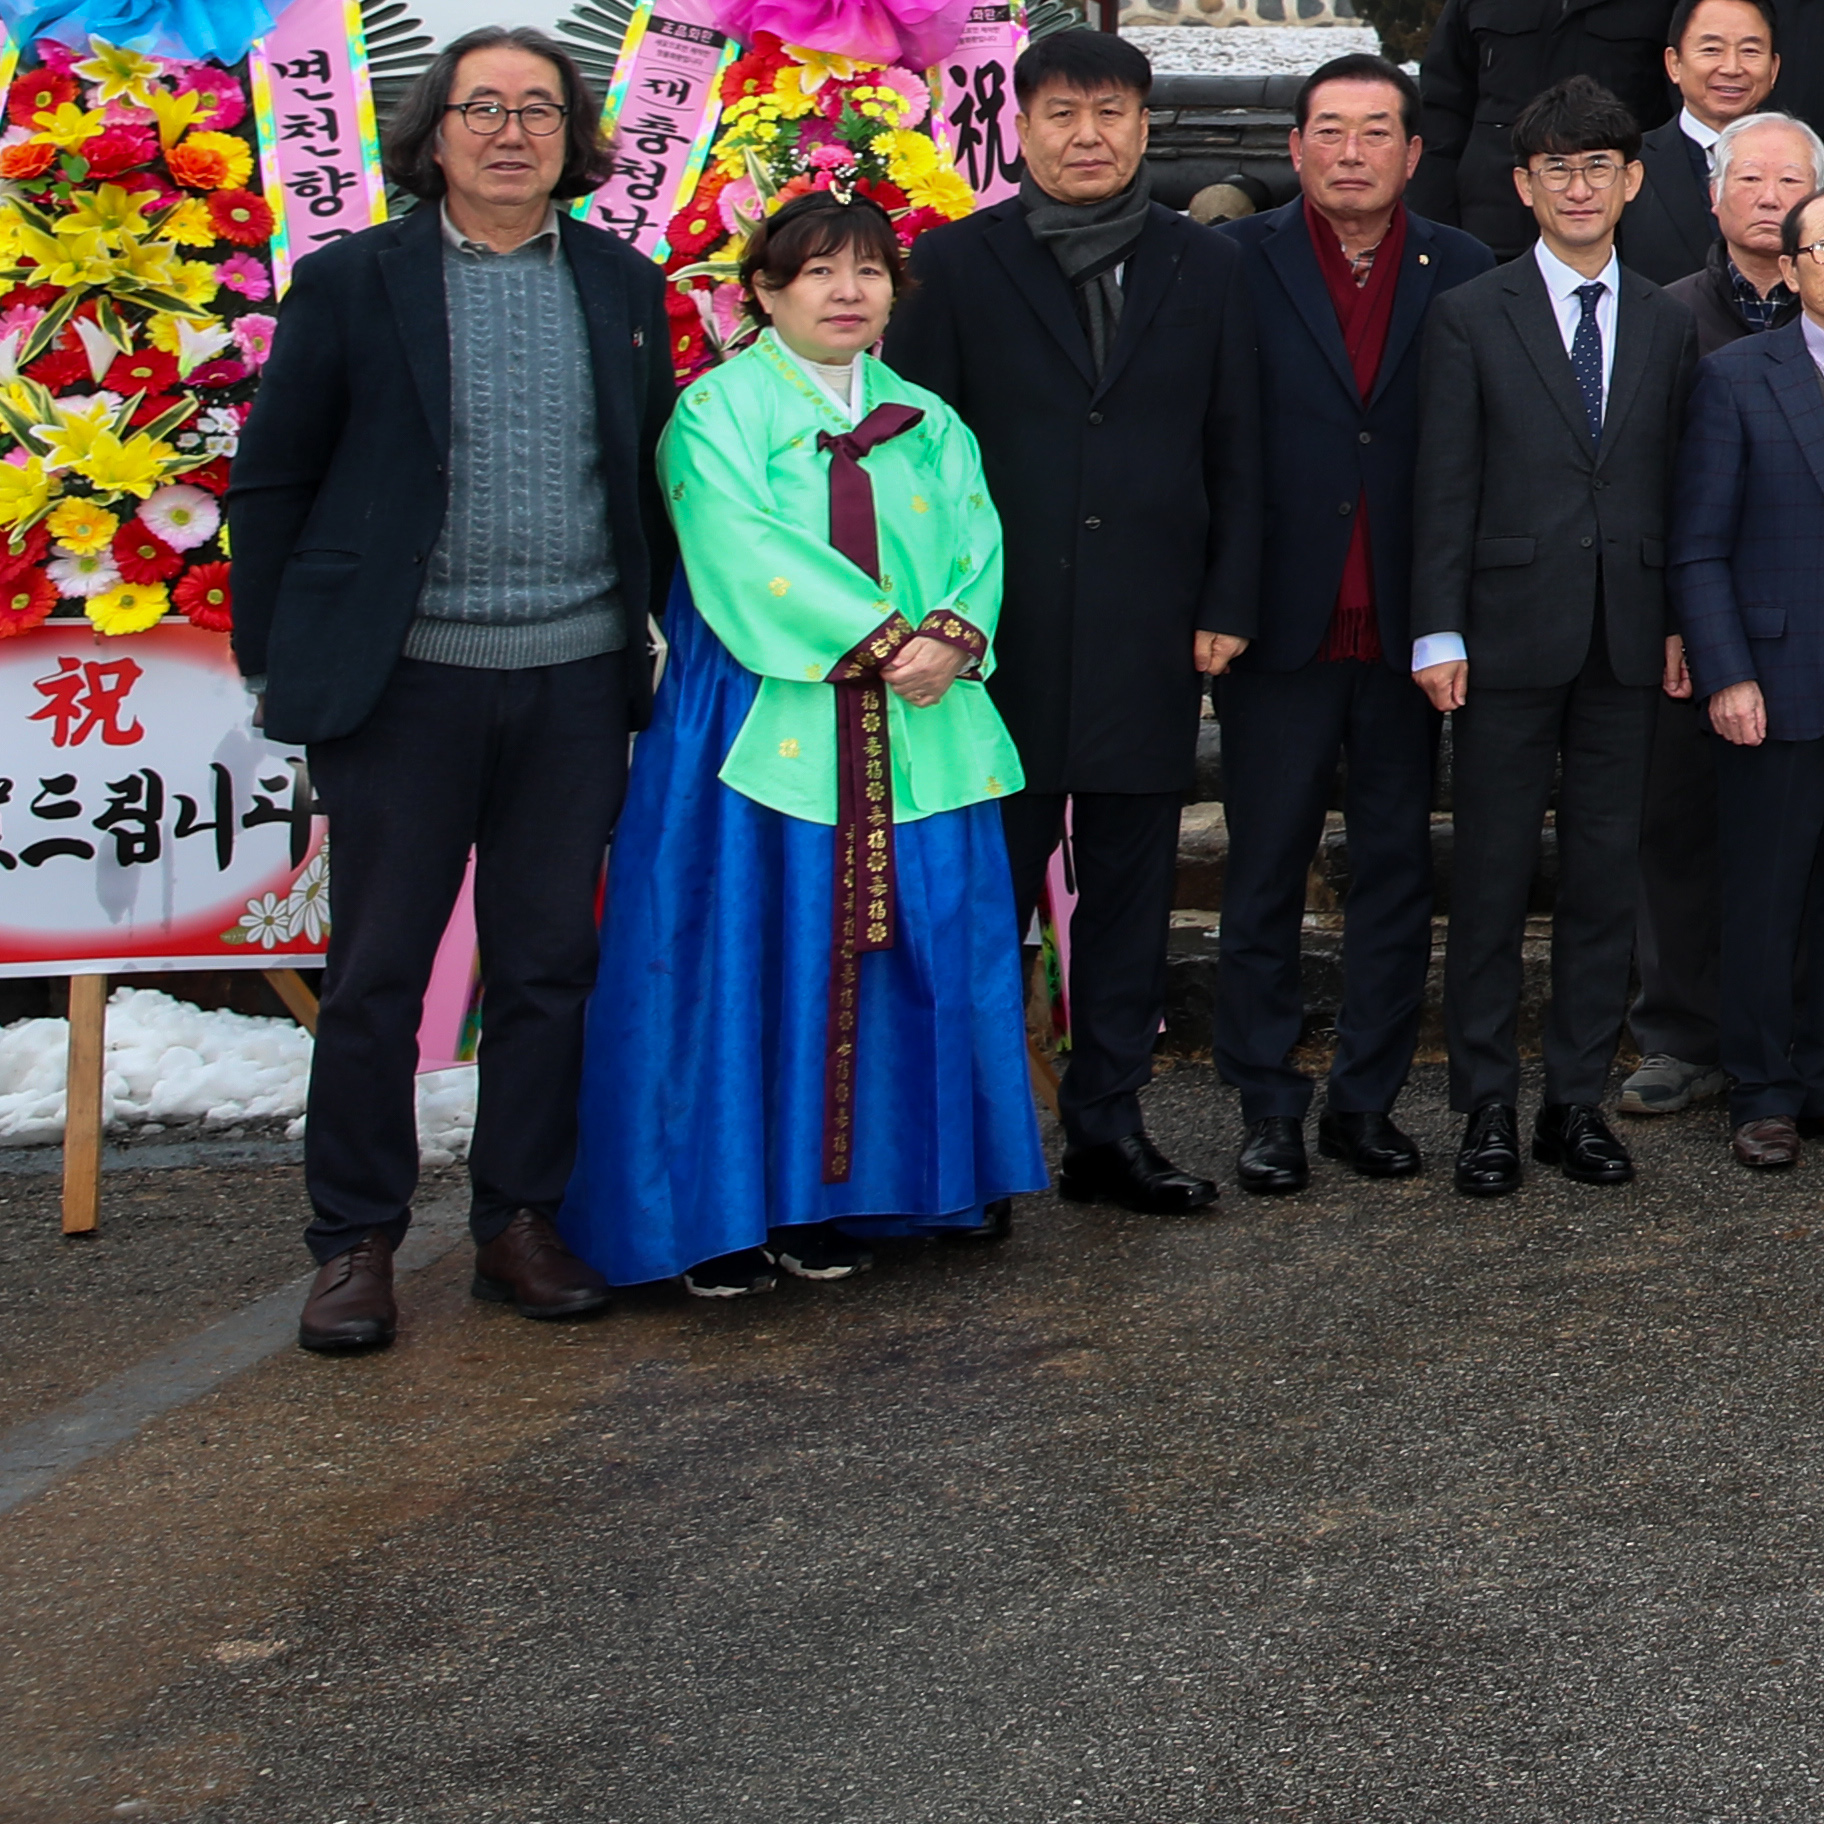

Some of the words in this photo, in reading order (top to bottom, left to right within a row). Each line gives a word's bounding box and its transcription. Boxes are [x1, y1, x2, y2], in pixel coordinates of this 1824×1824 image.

[270, 48, 359, 240] 면천향
[947, 59, 1025, 194] 祝
[25, 656, 145, 748] 祝
